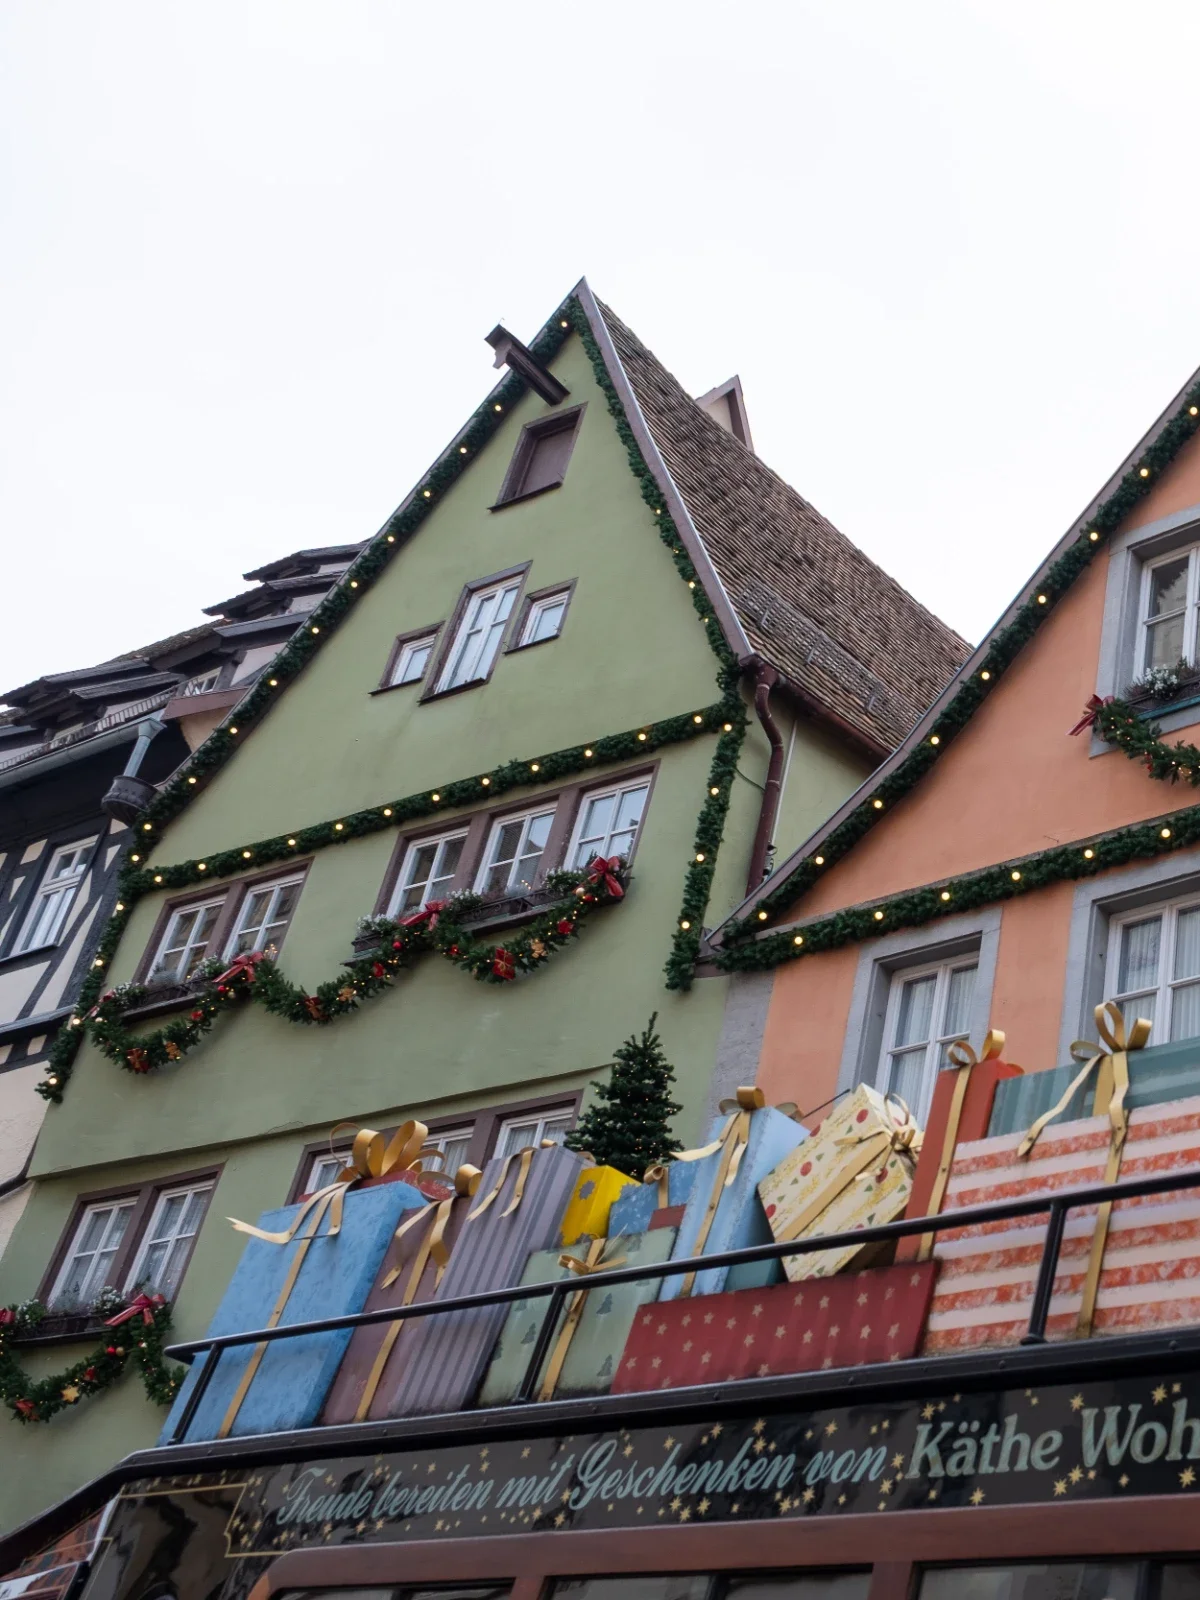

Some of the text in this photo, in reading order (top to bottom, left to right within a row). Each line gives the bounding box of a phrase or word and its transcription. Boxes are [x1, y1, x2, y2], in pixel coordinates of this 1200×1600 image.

[276, 1467, 374, 1525] Freude
[371, 1463, 495, 1519] bereiten
[495, 1452, 576, 1509] mit
[568, 1437, 796, 1511] Geschenken
[802, 1444, 889, 1486] von
[905, 1412, 1063, 1480] Käthe
